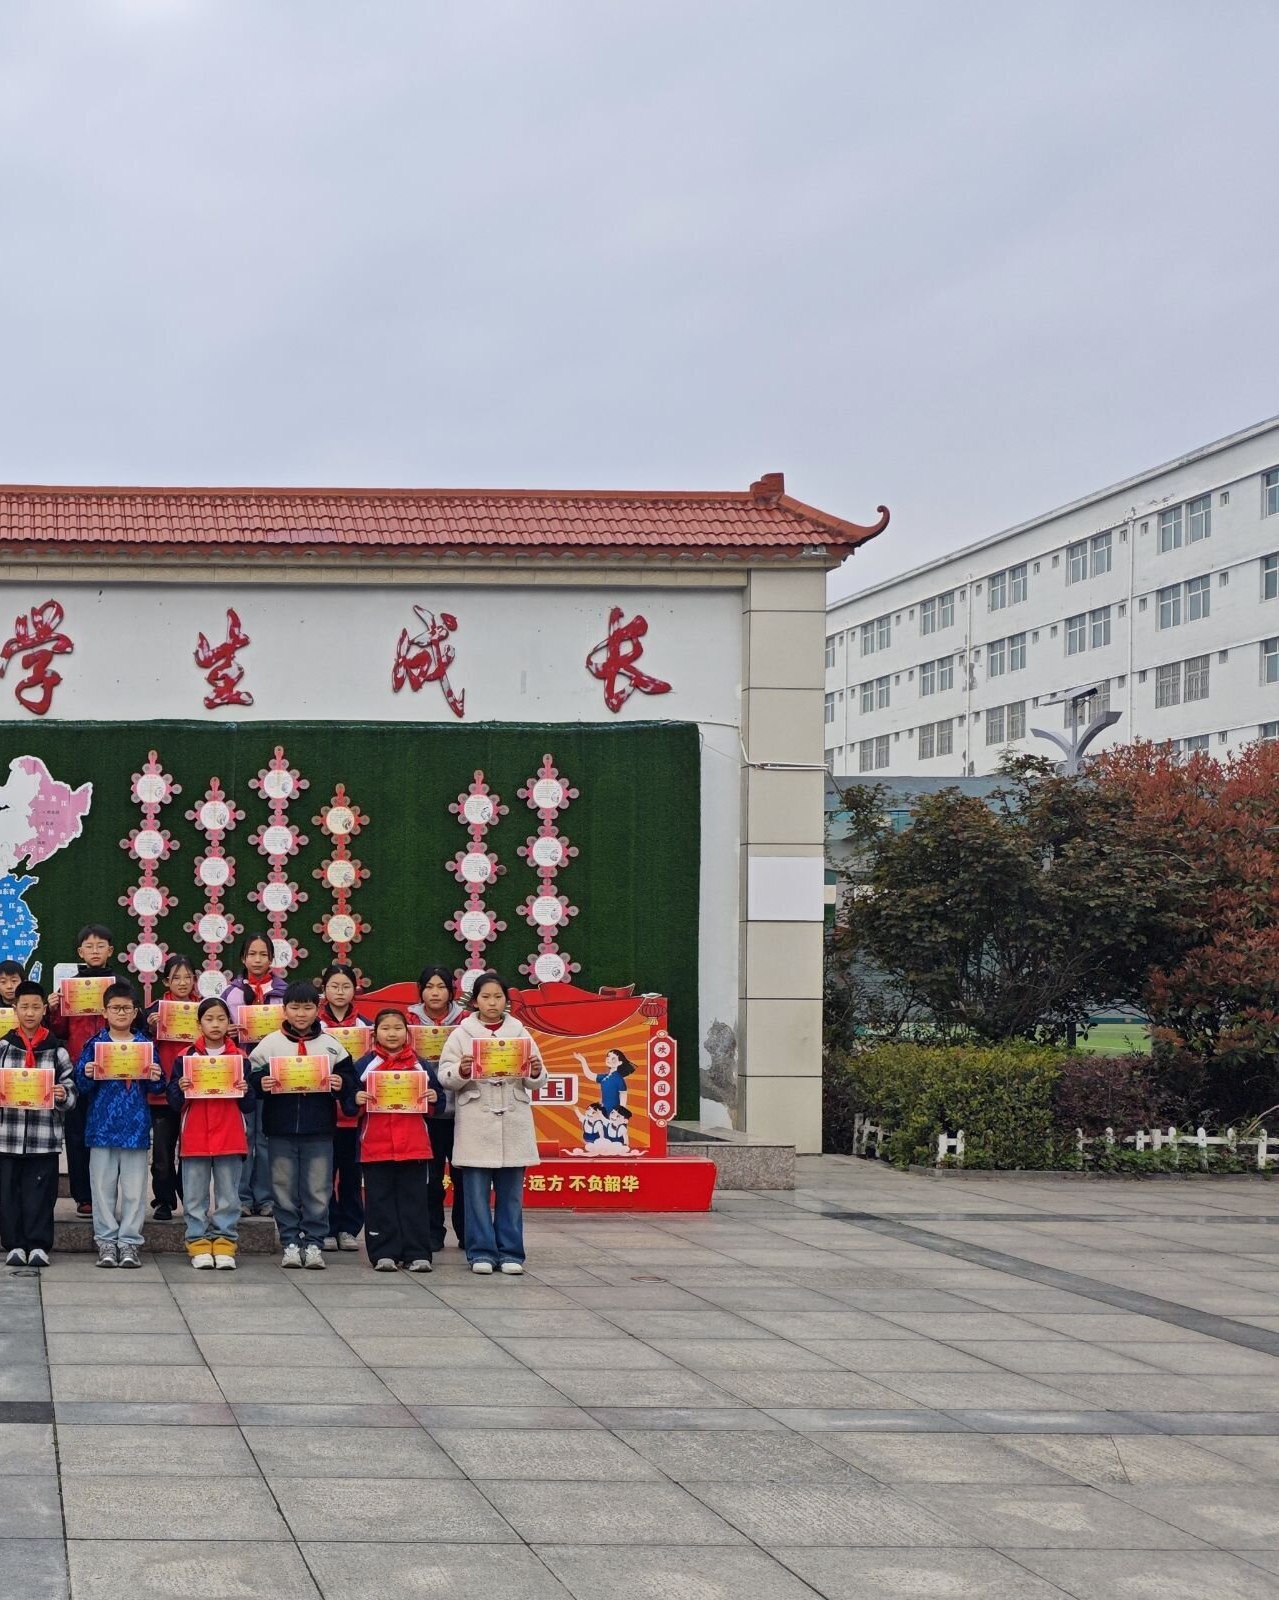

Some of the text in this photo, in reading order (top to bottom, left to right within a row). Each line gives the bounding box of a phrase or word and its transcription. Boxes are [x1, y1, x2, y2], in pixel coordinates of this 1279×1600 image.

[657, 1044, 668, 1113] 欢度国庆
[523, 1174, 641, 1193] 远方 不负韶华
